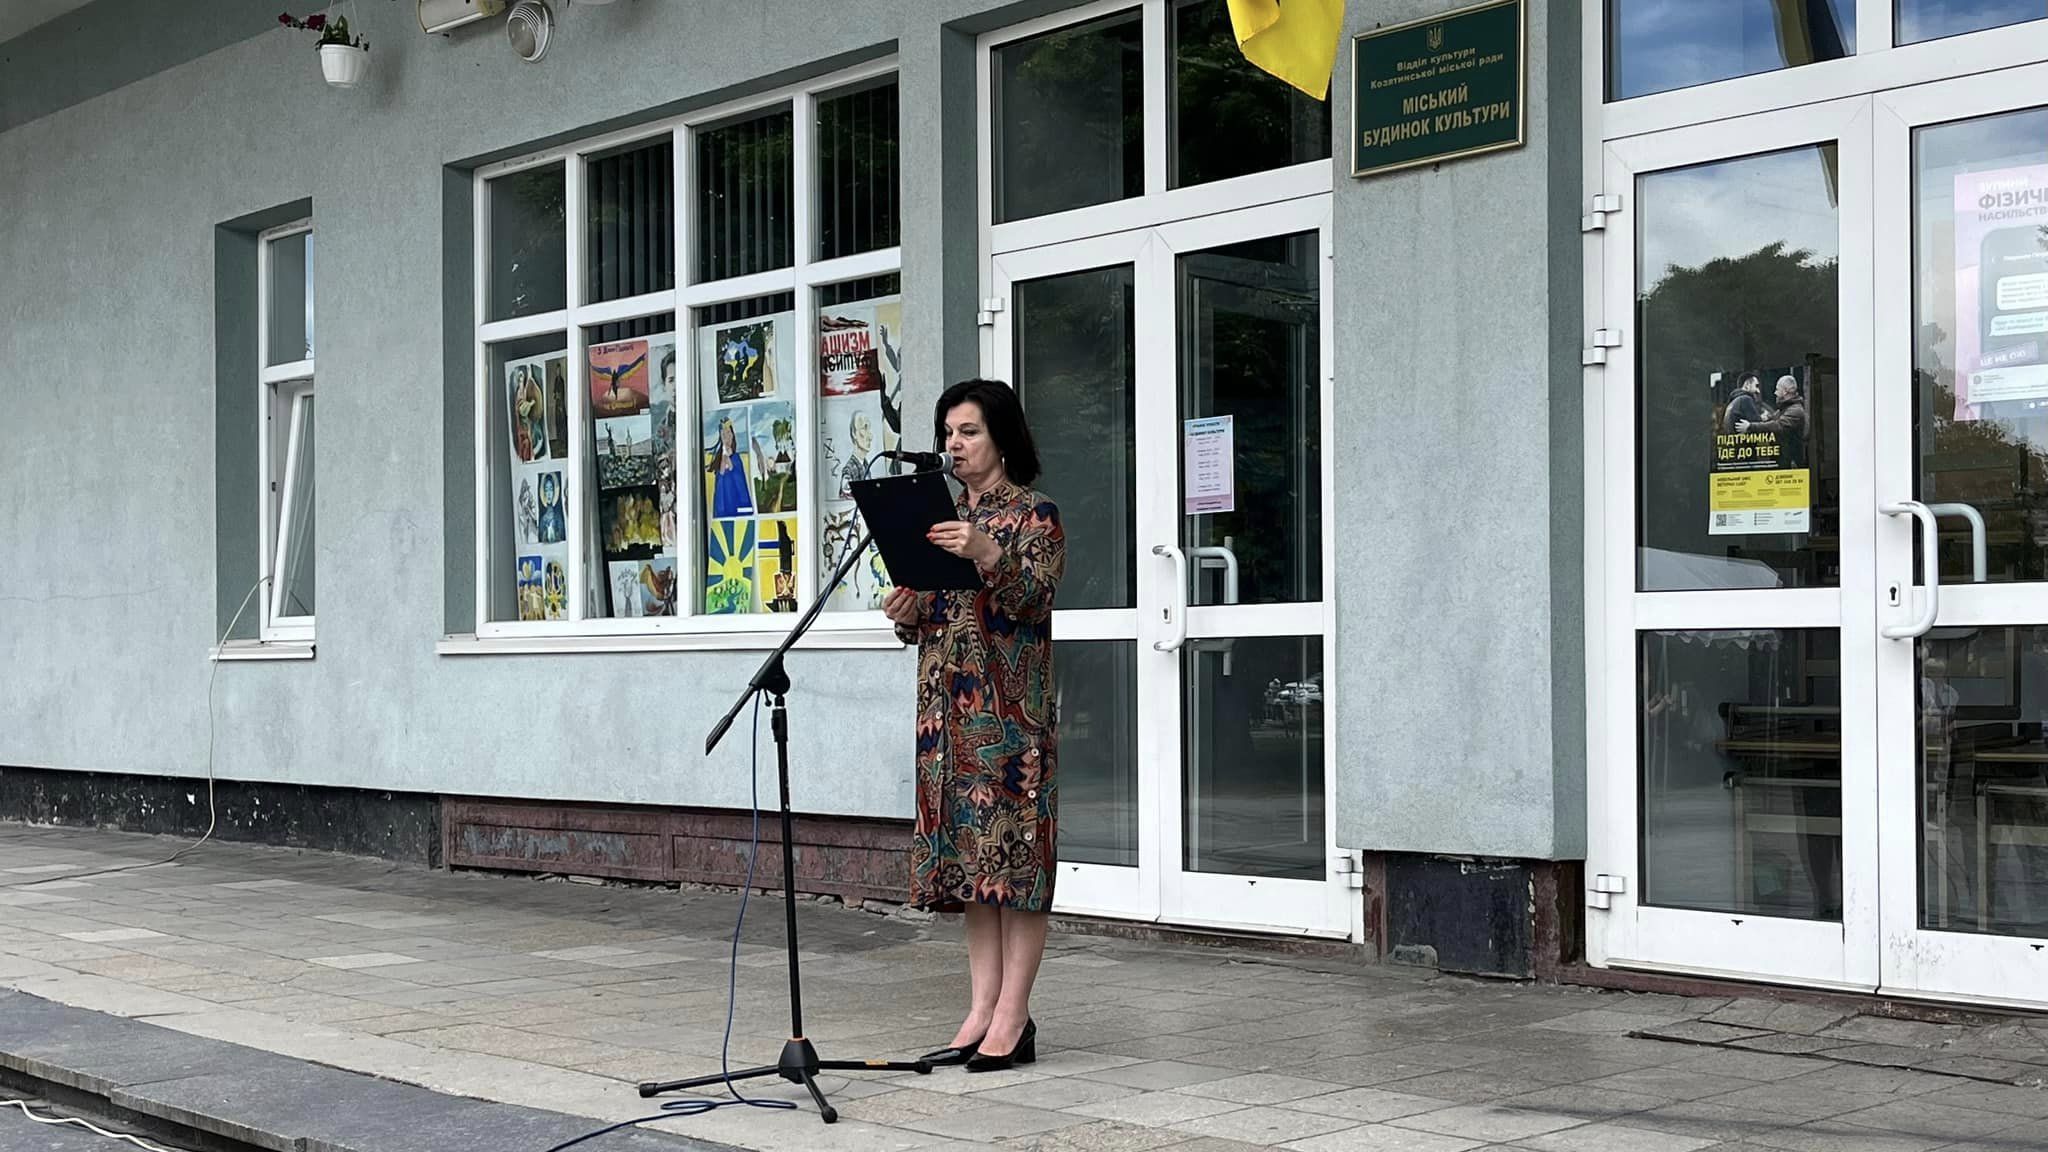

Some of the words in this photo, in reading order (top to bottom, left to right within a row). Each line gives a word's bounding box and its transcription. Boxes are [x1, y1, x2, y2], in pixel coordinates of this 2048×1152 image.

[1370, 69, 1436, 90] Козятинської
[1439, 60, 1476, 75] міської
[1478, 53, 1504, 67] ради
[1396, 59, 1428, 72] Відділ
[1430, 47, 1476, 65] культури
[1402, 82, 1469, 115] МІСЬКИЙ
[1363, 118, 1430, 148] БУДИНОК
[1435, 101, 1510, 133] КУЛЬТУРИ
[1979, 206, 2048, 222] НАСИЛЬСТВ
[821, 331, 871, 355] АШИЗМ
[1717, 431, 1776, 446] ПІДТРИМКА
[1717, 447, 1735, 460] ЇДЕ
[1737, 447, 1752, 460] ДО
[1755, 445, 1780, 457] ТЕБЕ
